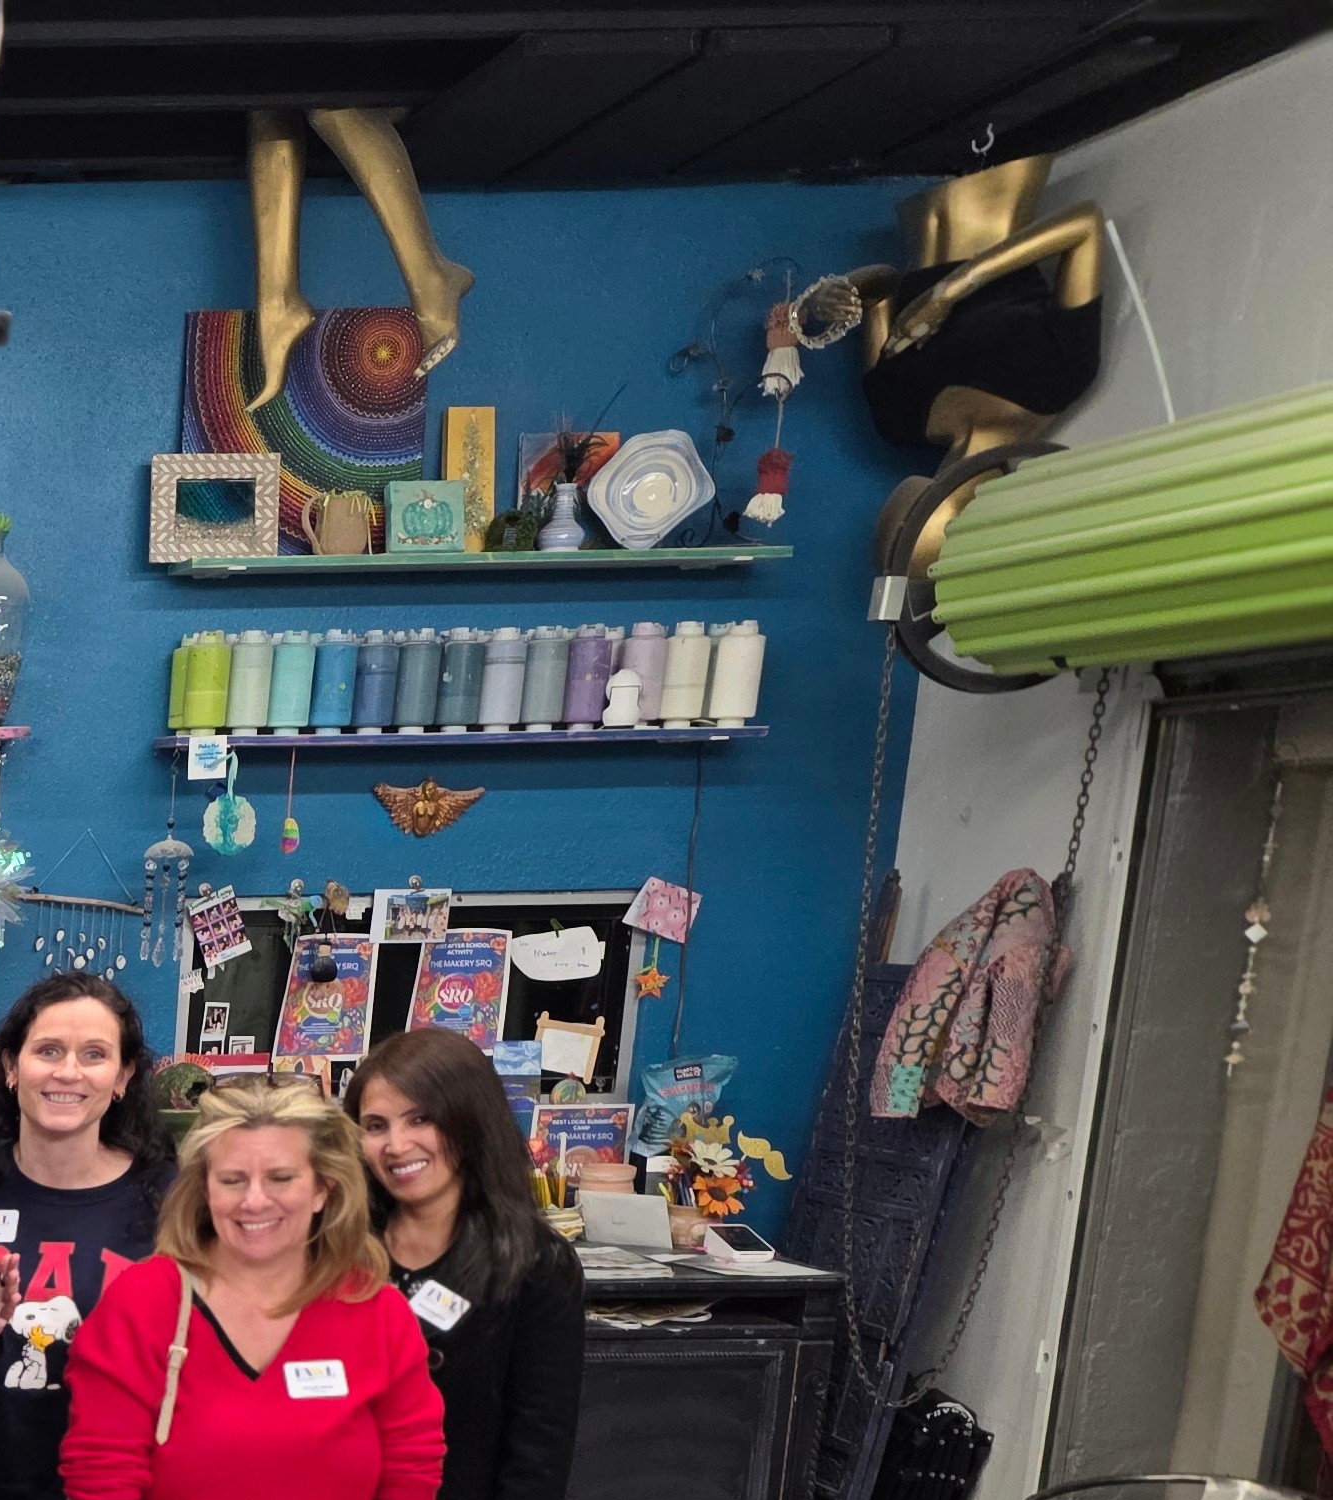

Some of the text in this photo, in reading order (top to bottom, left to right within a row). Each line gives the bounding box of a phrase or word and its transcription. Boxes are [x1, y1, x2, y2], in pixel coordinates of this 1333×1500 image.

[430, 959, 493, 969] THE MAKERY SRQ
[439, 988, 474, 1006] SRQ
[566, 1132, 596, 1141] MAKERY
[597, 1132, 614, 1141] SRQ
